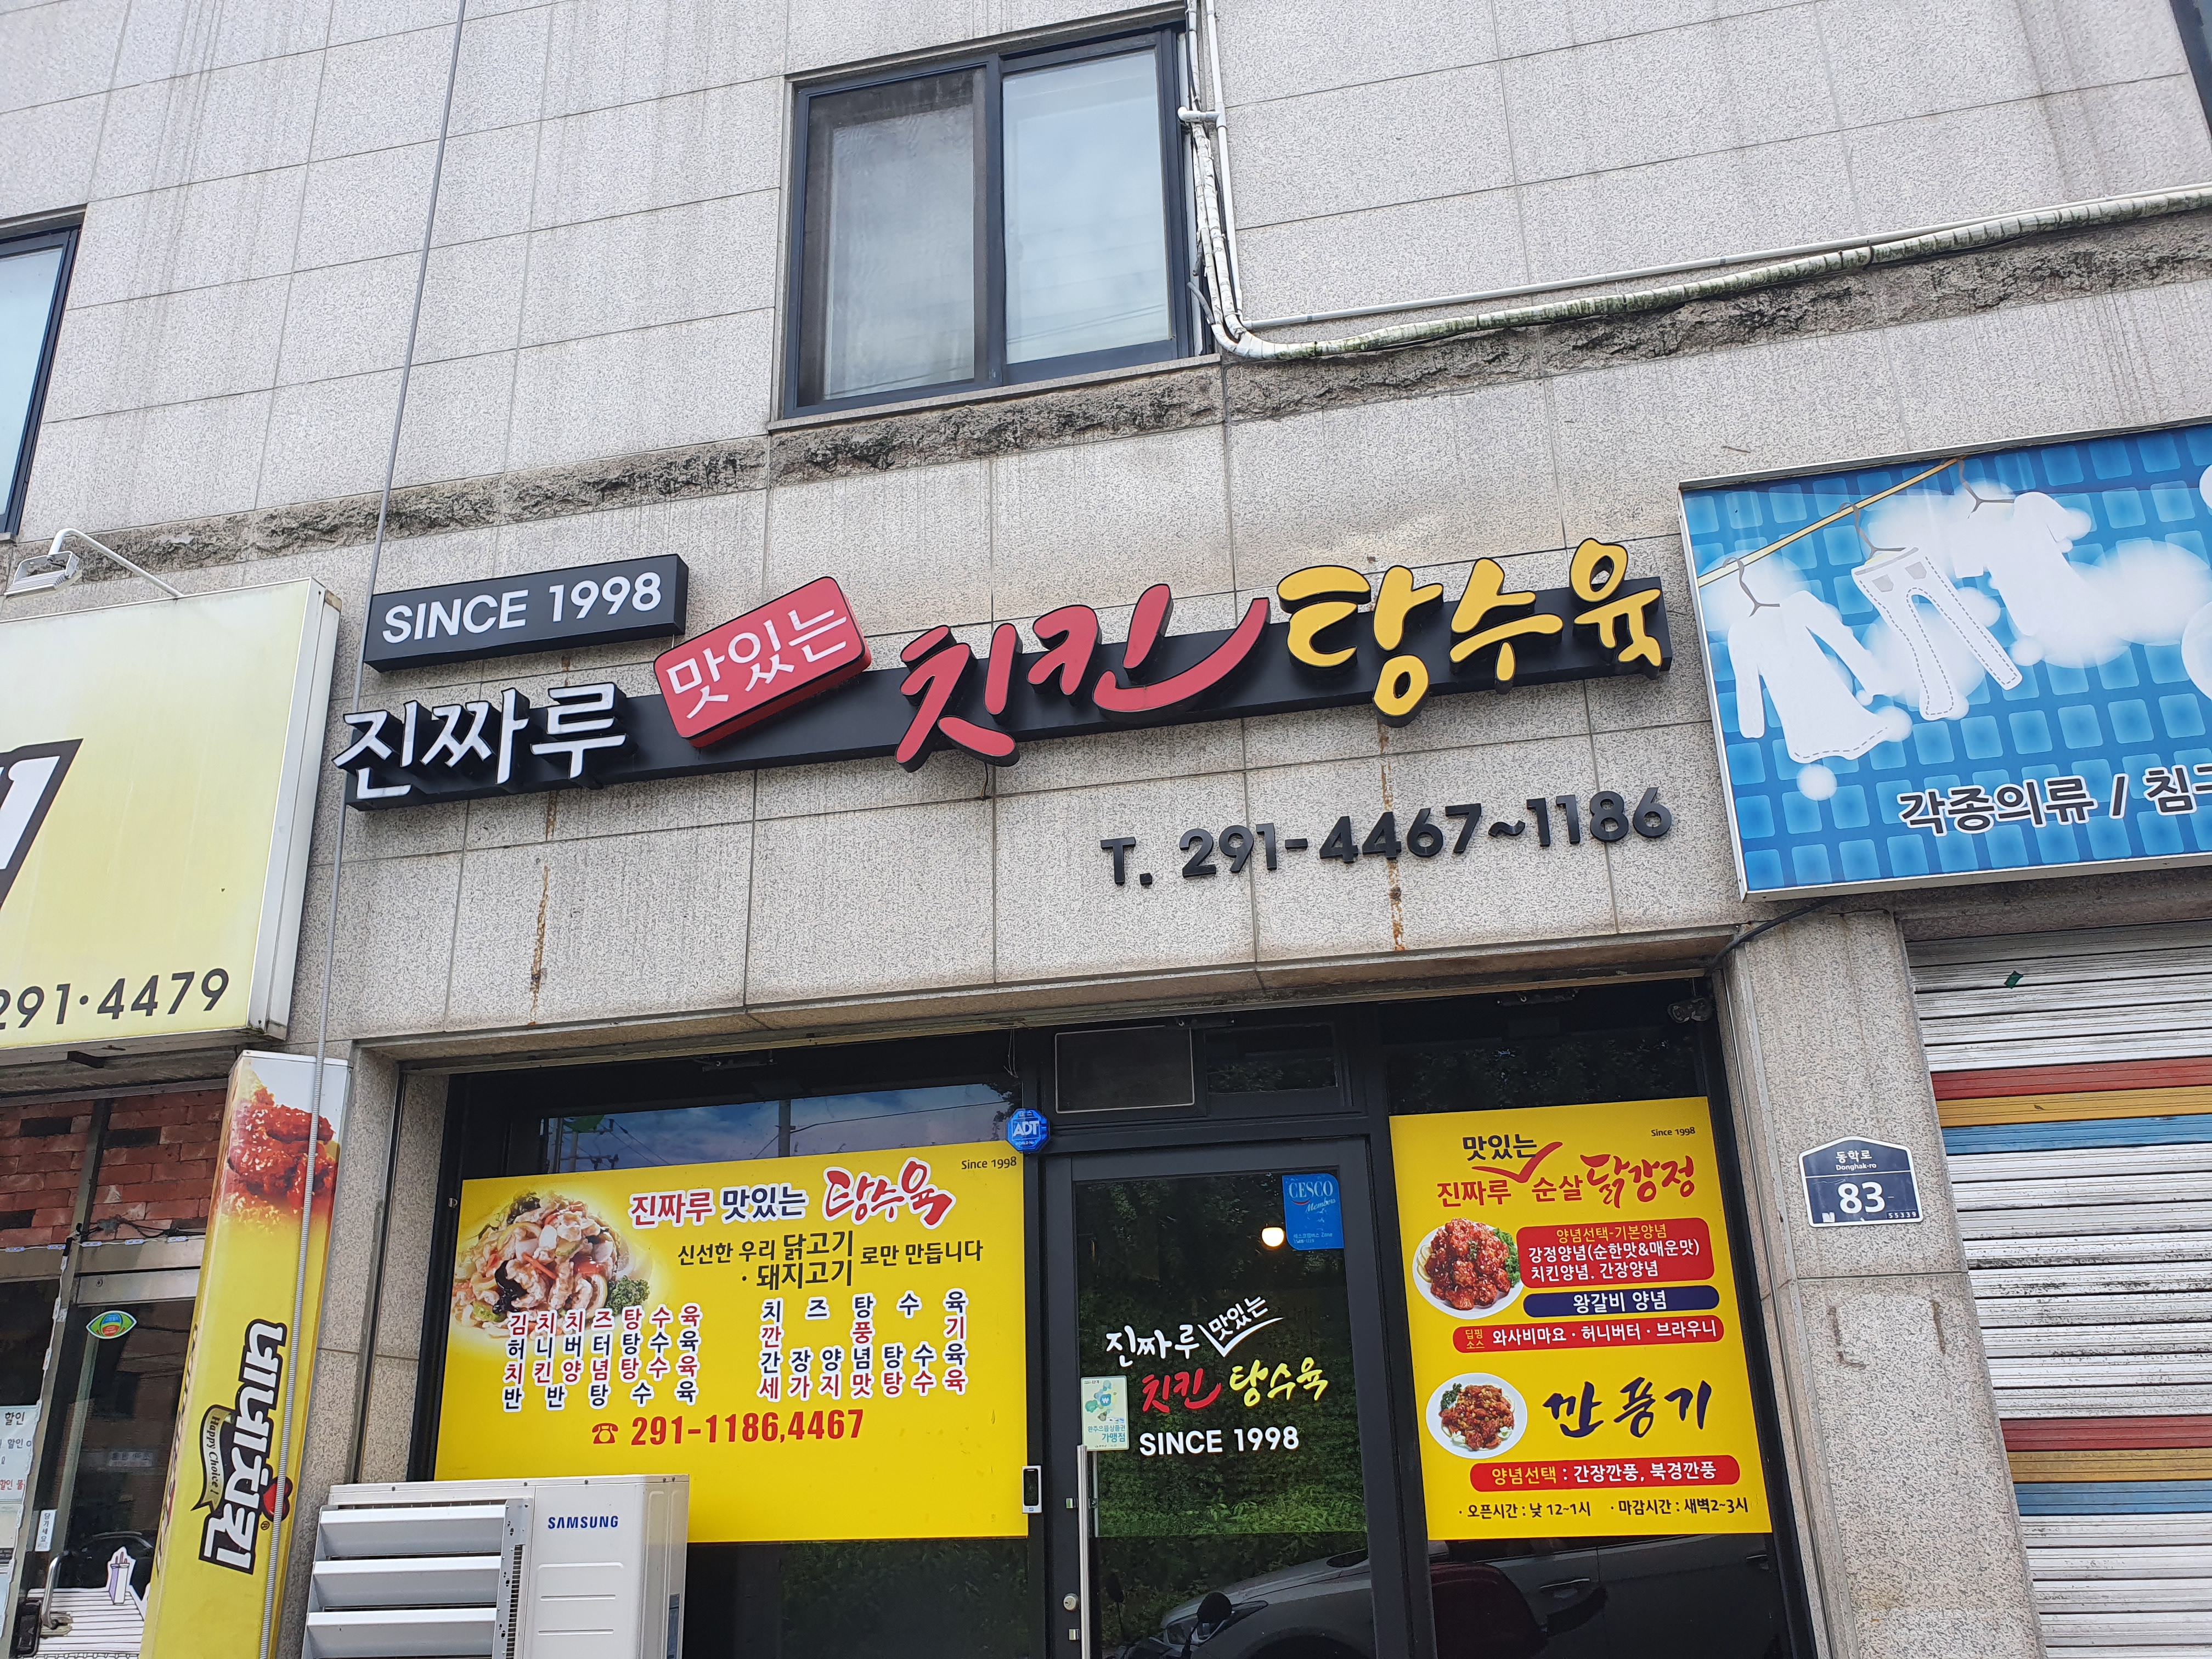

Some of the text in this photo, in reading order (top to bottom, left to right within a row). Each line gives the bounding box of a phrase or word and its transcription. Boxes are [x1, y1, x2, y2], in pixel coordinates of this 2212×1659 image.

[382, 571, 662, 644] SINCE 1998
[332, 538, 1661, 799] 진짜루 맛있는 치킨 탕수육
[1900, 777, 2095, 834] 각종의류
[1100, 786, 1673, 887] T. 291-4467~1186
[1013, 1121, 1039, 1137] ADT
[1651, 1126, 1696, 1137] Since 1998
[1462, 1134, 1537, 1161] 맛있는
[1836, 1150, 1872, 1164] 동학로
[961, 1156, 1017, 1170] Since 1998
[1836, 1163, 1877, 1171] Donghak-ro
[630, 1157, 955, 1228] 진짜루 맛있는 탕수육
[1289, 1181, 1333, 1198] CESCO
[1437, 1153, 1694, 1209] 진짜루 순살 닭강정
[1305, 1197, 1336, 1212] Members
[1556, 1224, 1667, 1244] 양념선택-기본양념
[678, 1231, 983, 1266] 신선한 우리 닭고기 로만 만듭니다
[756, 1261, 853, 1290] 돼지고기
[1599, 1260, 1658, 1279] 간장양념
[1573, 1290, 1667, 1314] 왕갈비 양념
[1105, 1295, 1269, 1367] 진짜루 맛있는
[1492, 1319, 1717, 1346] 와사비마요 허니버터 브라우니
[1466, 1340, 1485, 1350] 소스
[1141, 1356, 1329, 1414] 치킨 탕수육
[5, 1412, 25, 1426] 할인
[631, 1410, 864, 1446] 291-1186,4467
[8, 1438, 23, 1449] 할인
[204, 1322, 283, 1570] 네네치킨
[205, 1417, 221, 1451] Happy
[1102, 1432, 1125, 1443] 가맹점
[1139, 1426, 1300, 1457] SINCE 1998
[1492, 1466, 1556, 1485] 양념선택
[1650, 1461, 1717, 1481] 북경깐풍
[1467, 1503, 1518, 1520] 오픈시간
[1529, 1502, 1542, 1519] 낮
[1547, 1500, 1591, 1516] 12~1시
[1618, 1499, 1672, 1516] 마감시간
[41, 1513, 51, 1542] 당기세요
[548, 1515, 619, 1529] SAMSUNG
